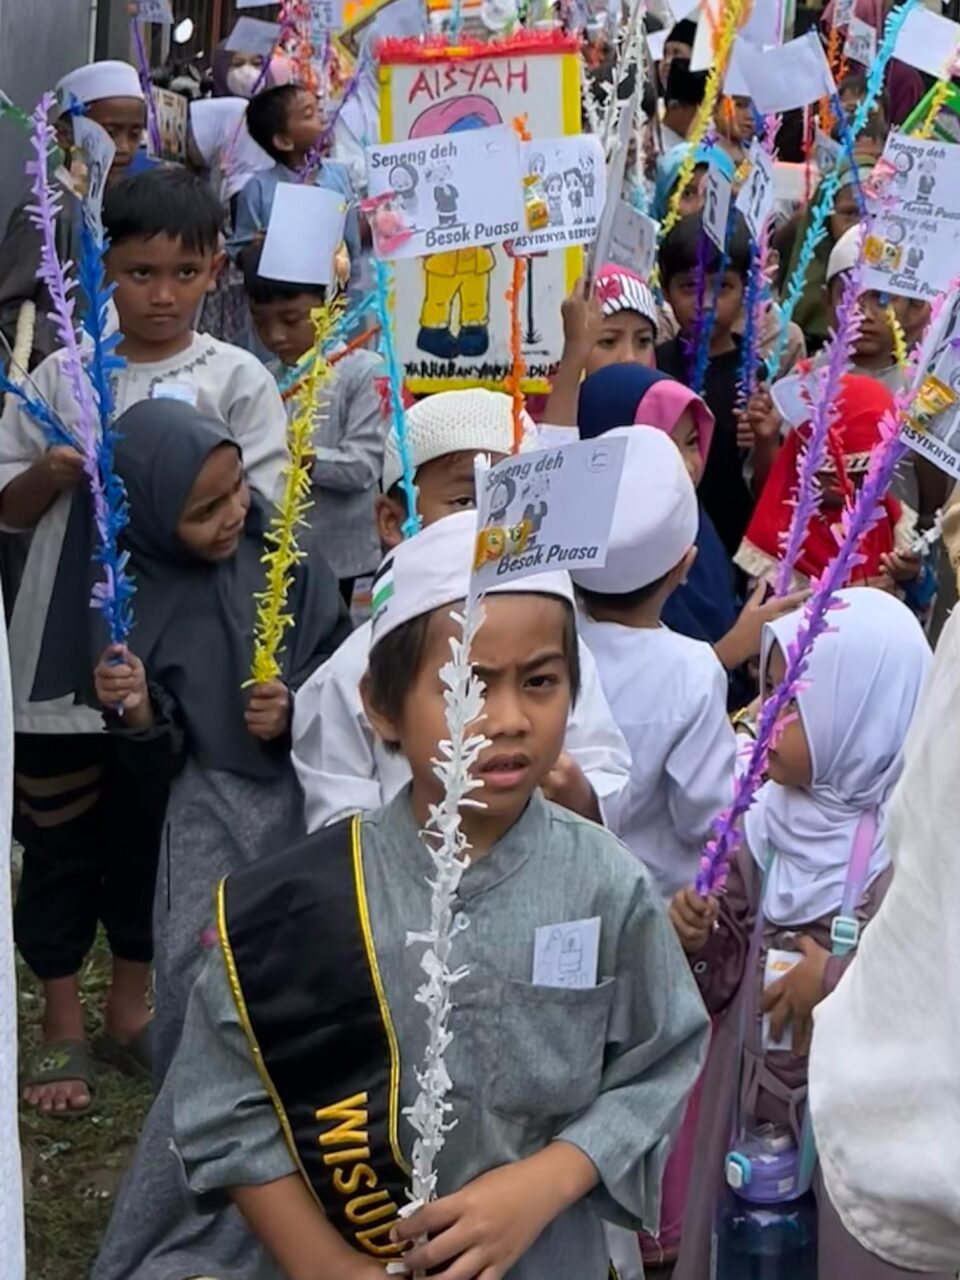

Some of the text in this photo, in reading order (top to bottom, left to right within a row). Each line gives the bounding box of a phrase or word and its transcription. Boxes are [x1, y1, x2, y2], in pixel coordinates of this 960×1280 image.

[408, 61, 528, 104] AISYAH
[371, 141, 457, 169] Seneng deh
[425, 220, 519, 248] Besok Puasa
[515, 231, 567, 247] ASYIKNYA
[901, 424, 956, 468] ASYIKNYA
[534, 450, 565, 473] deh
[496, 544, 599, 576] Besok Puasa
